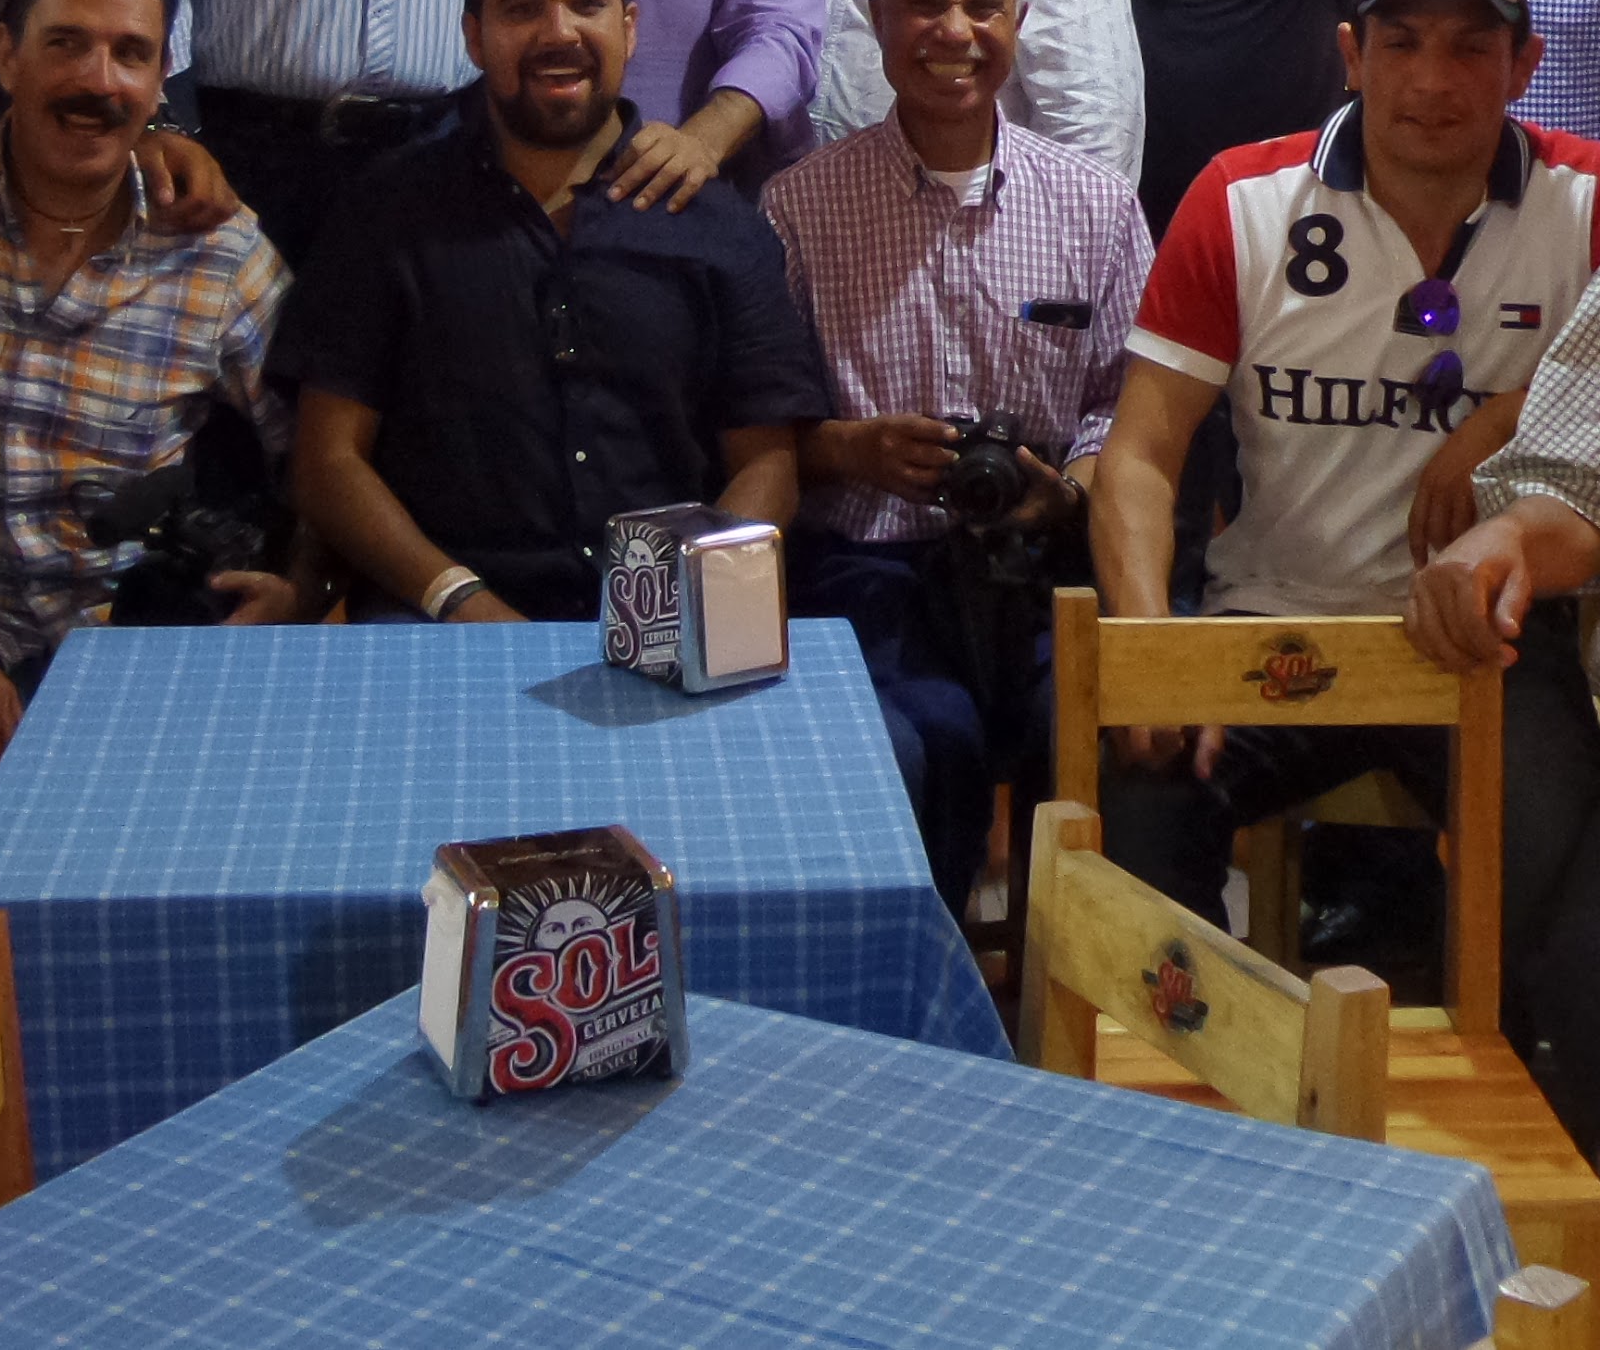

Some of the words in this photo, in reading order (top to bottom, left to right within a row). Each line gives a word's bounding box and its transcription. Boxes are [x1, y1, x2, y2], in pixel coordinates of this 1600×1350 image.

[1284, 212, 1350, 298] 8
[605, 564, 680, 670] SOL
[488, 914, 661, 1095] SOL
[583, 993, 663, 1040] CERVEZA
